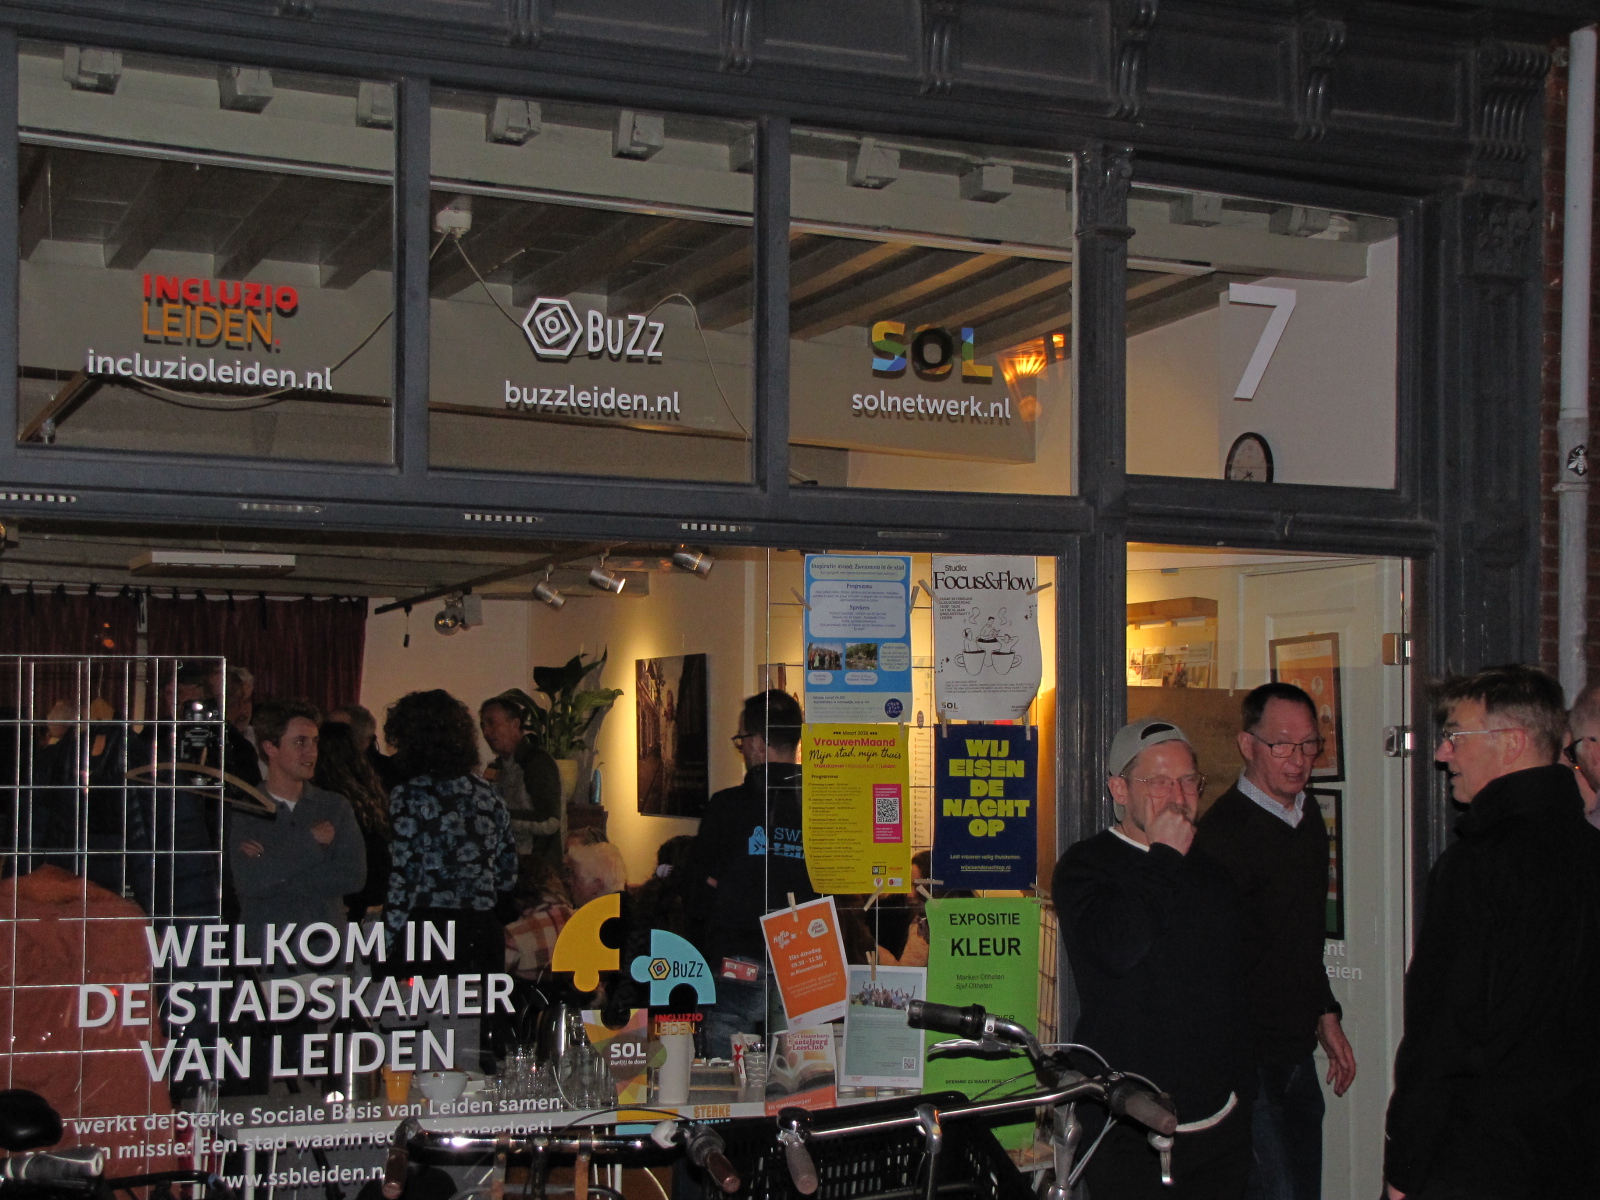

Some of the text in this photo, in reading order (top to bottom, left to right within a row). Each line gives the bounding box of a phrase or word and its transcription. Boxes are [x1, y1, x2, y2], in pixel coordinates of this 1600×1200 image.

[143, 274, 298, 309] INCLUZIO
[871, 320, 994, 378] SOL
[1229, 282, 1296, 401] 7
[87, 349, 333, 391] incluzioleiden.nl
[505, 380, 681, 414] buzzleiden.nl
[851, 390, 1011, 419] solnetwerk.nl
[933, 570, 1035, 590] Focus&Flow
[814, 738, 896, 747] VrouwenMaand
[965, 739, 1010, 757] WIJ
[809, 749, 832, 764] Mijn
[949, 759, 1024, 778] EISEN
[970, 779, 1004, 797] DE
[943, 799, 1030, 817] NACHT
[968, 819, 1005, 837] OP
[949, 913, 1020, 925] EXPOSITIE
[145, 920, 456, 968] WELKOM IN
[951, 937, 1021, 956] KLEUR
[78, 973, 515, 1028] DE STADSKAMER
[655, 1013, 703, 1022] INCLUZIO
[140, 1029, 455, 1082] VAN LEIDEN
[611, 1043, 646, 1058] SOL
[74, 1115, 137, 1134] werkt
[148, 1114, 171, 1131] de
[177, 1109, 244, 1129] Sterke
[251, 1104, 325, 1125] Sociale
[332, 1101, 381, 1121] Basis
[387, 1102, 422, 1117] van
[428, 1096, 493, 1116] Leiden
[693, 1105, 731, 1119] STERKE
[119, 1141, 191, 1159] missie:
[200, 1139, 238, 1156] Een
[244, 1133, 287, 1151] stad
[294, 1129, 362, 1149] waarin
[222, 1165, 386, 1189] ww.ssbleiden.n
